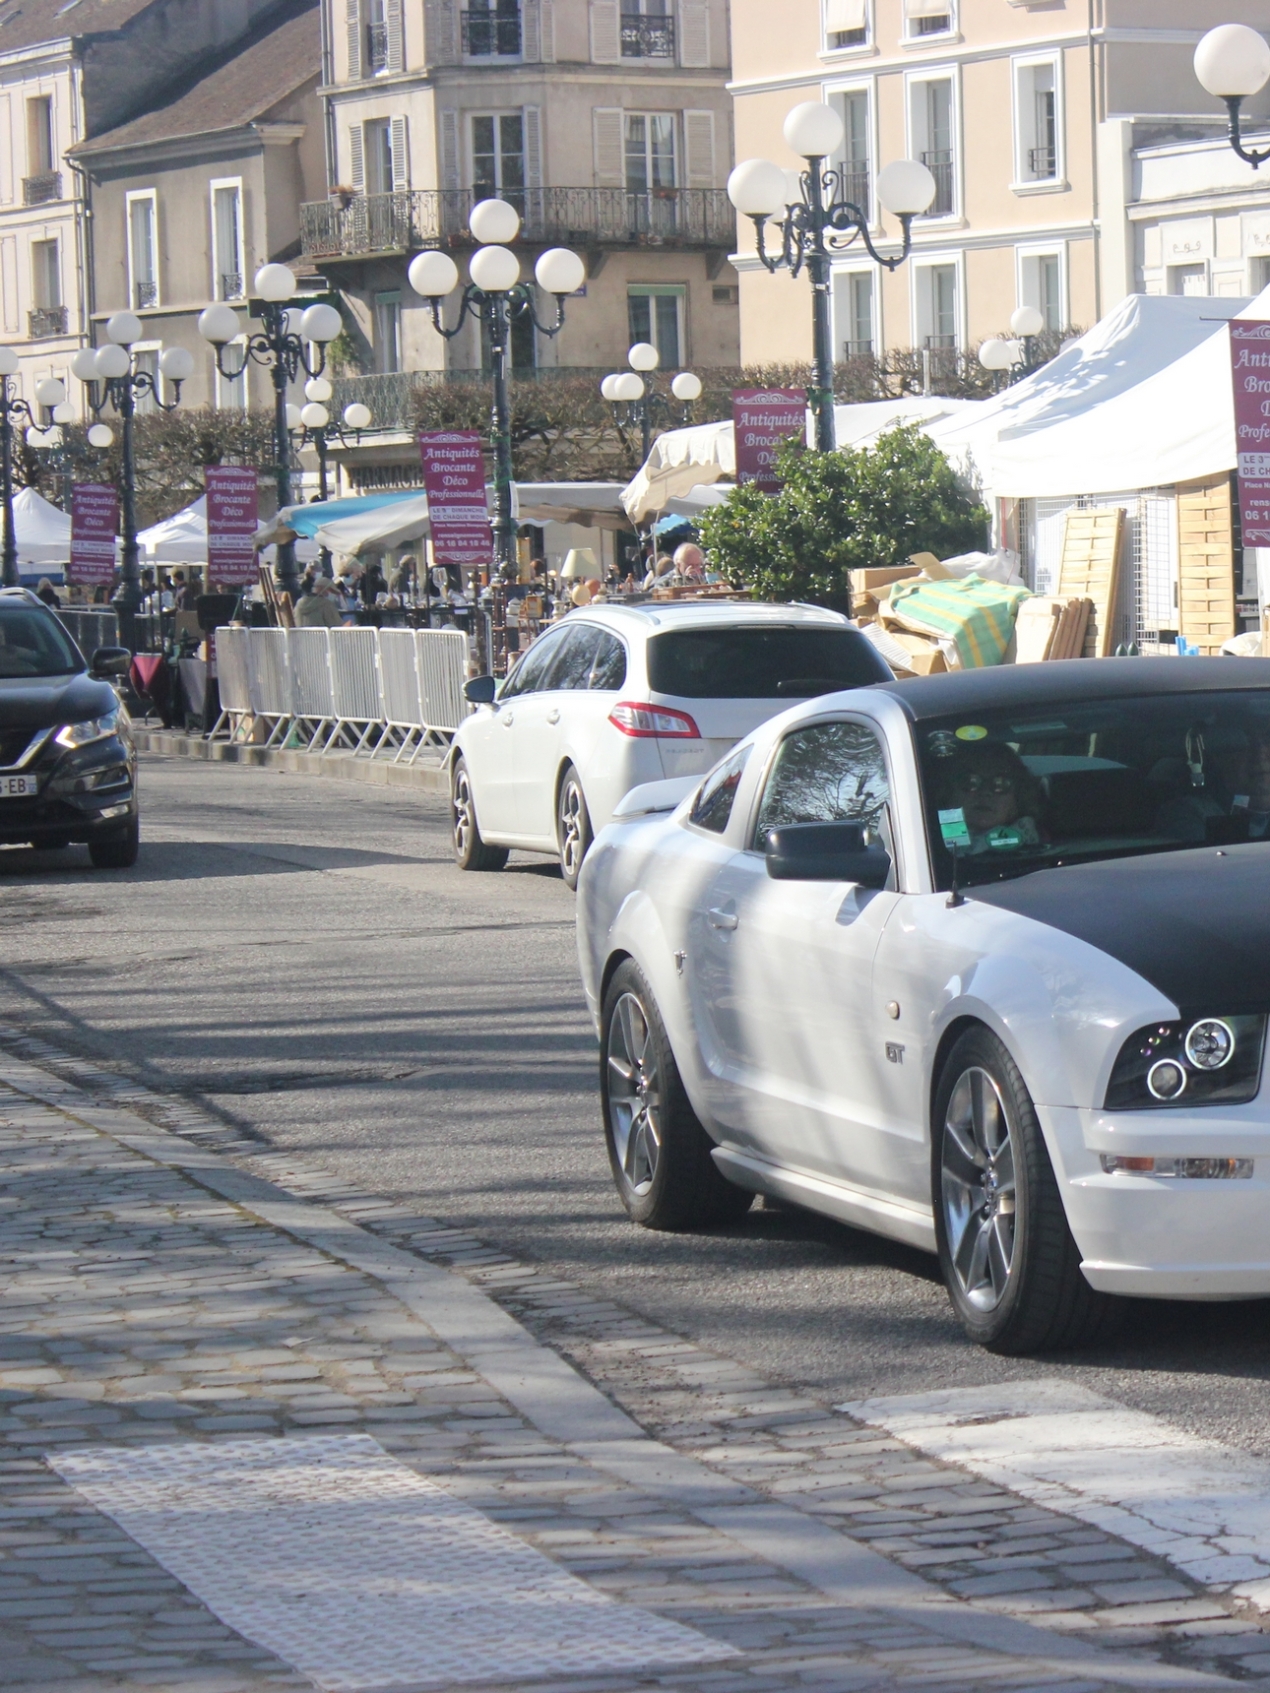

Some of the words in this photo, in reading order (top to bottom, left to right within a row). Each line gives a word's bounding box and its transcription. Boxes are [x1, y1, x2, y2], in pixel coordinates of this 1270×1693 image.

[736, 411, 805, 431] Antiquités
[744, 432, 783, 446] Broca
[424, 447, 480, 461] Antiquités
[1244, 455, 1256, 464] LE
[431, 462, 476, 473] Brocante
[1243, 467, 1255, 475] DE
[442, 475, 468, 486] Déco
[208, 480, 256, 493] Antiquités
[212, 493, 251, 504] Brocante
[428, 488, 485, 500] Professionnelle
[221, 506, 244, 516] Déco
[1244, 510, 1259, 520] 06
[885, 1041, 905, 1064] GT
